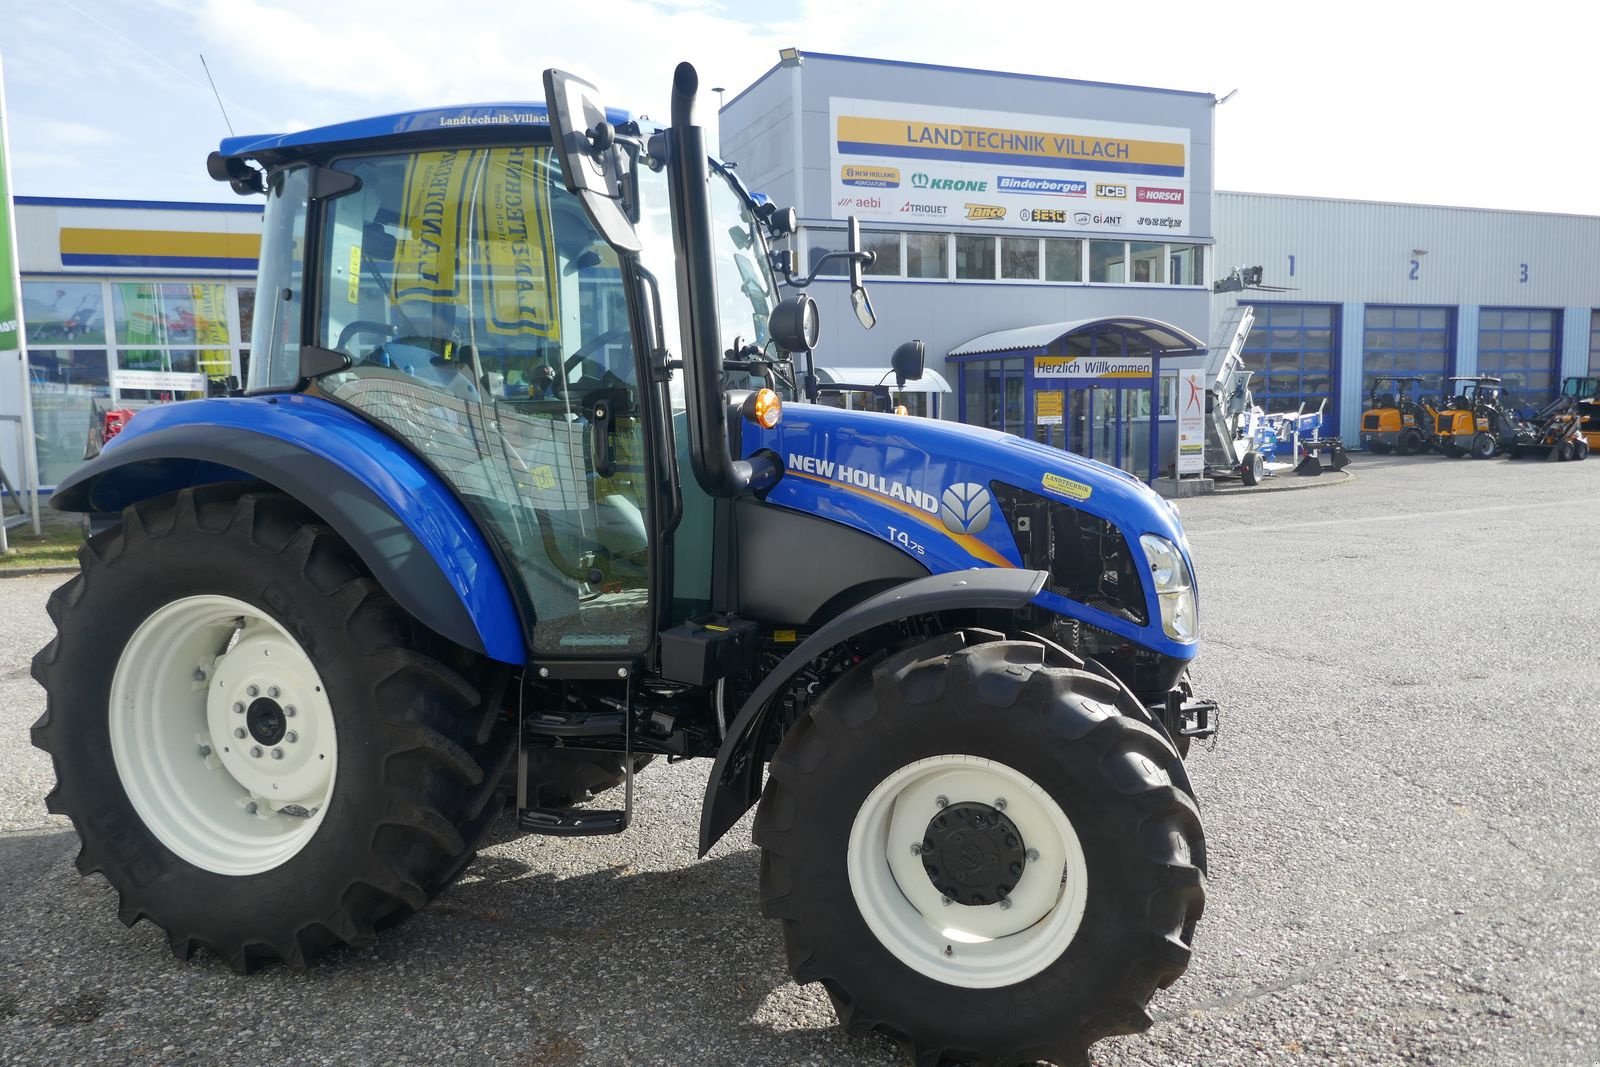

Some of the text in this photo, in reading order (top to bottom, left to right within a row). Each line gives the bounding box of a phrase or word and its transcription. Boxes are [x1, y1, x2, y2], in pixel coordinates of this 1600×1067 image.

[906, 125, 1130, 160] LANDTECHNIK VILLACH
[854, 170, 896, 179] NEW HOLLAND
[930, 178, 988, 192] KRONE
[999, 178, 1085, 192] Binderberger
[1097, 185, 1126, 197] JCB
[855, 196, 881, 208] aebi
[1146, 191, 1182, 201] HORSCH
[910, 203, 948, 214] TRIOLIET
[964, 203, 1006, 220] Tanco
[1287, 255, 1295, 276] 1
[1408, 260, 1420, 280] 2
[1519, 263, 1529, 283] 3
[1036, 360, 1150, 375] Herzlich Willkommen
[788, 453, 939, 514] NEW HOLLAND
[1045, 474, 1089, 493] LANDTECHNIK
